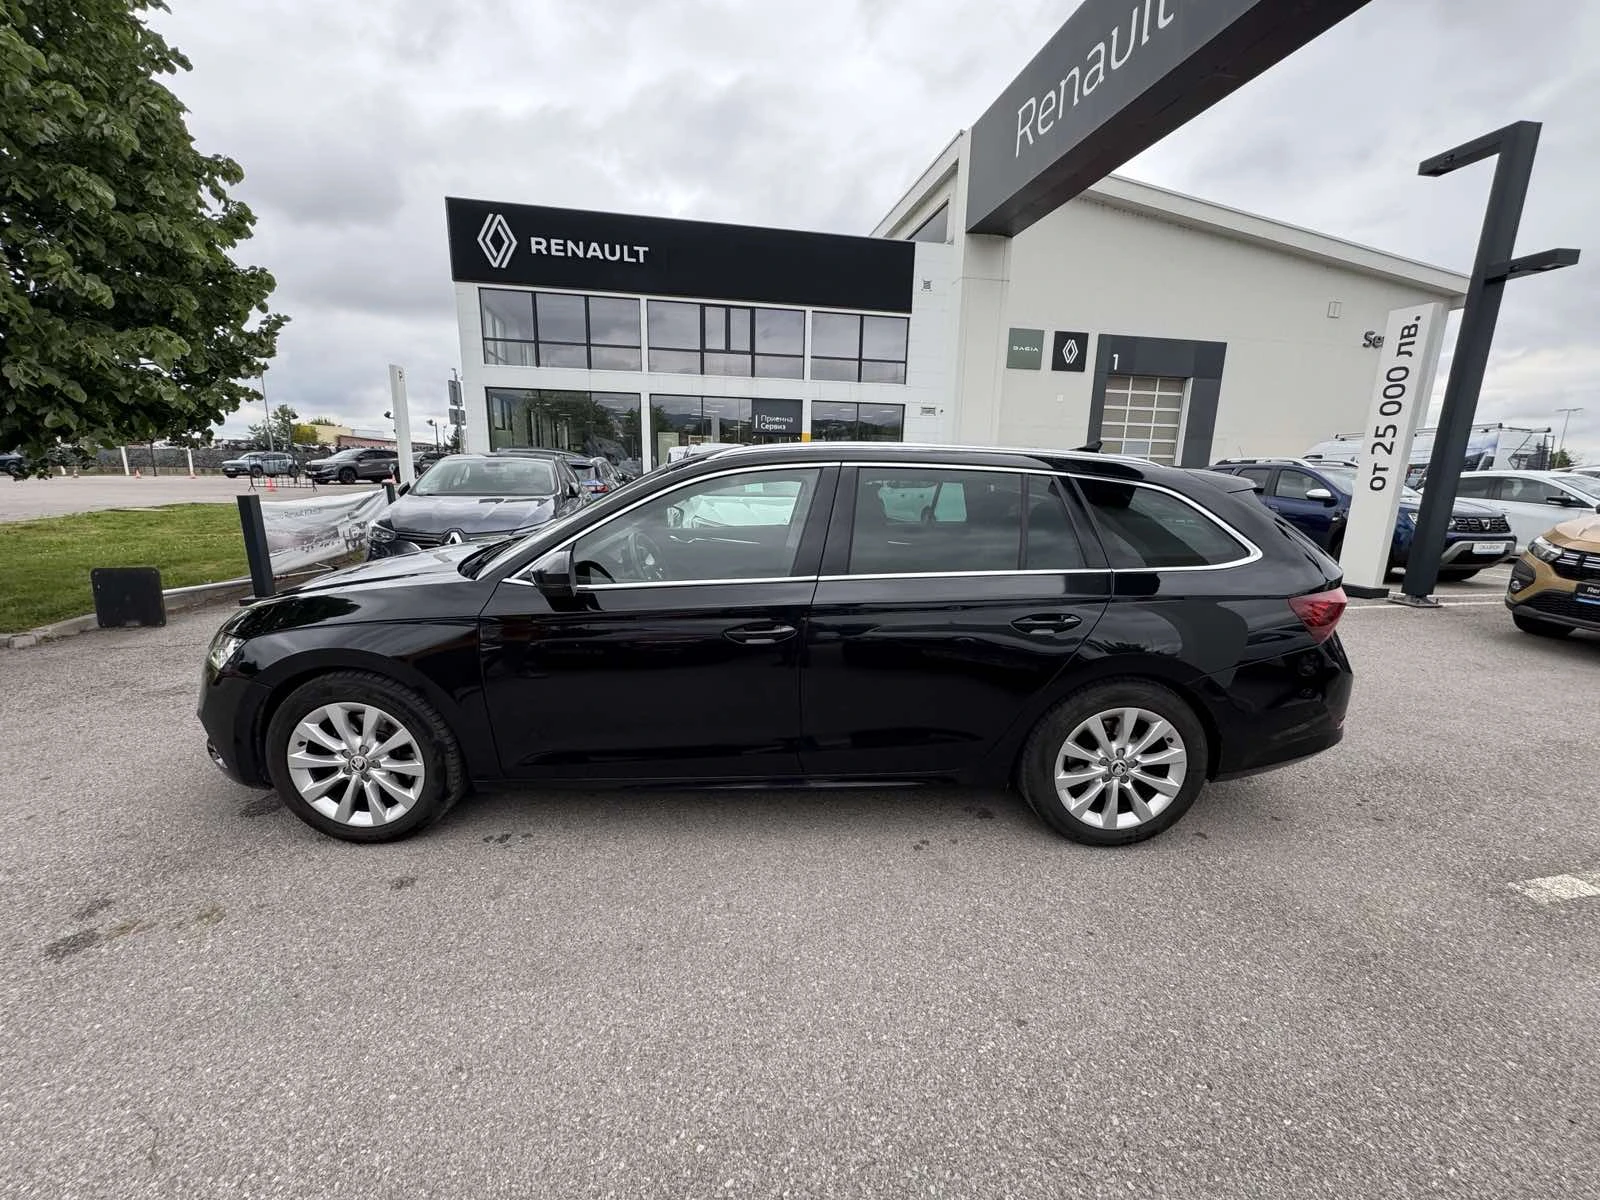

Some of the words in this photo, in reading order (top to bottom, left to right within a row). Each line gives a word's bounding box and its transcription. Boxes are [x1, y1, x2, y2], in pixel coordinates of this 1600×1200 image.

[530, 236, 649, 263] RENAULT
[1396, 315, 1421, 357] лв.
[1113, 353, 1119, 371] 1
[1379, 366, 1409, 416] 000
[1371, 424, 1397, 455] 25
[1369, 462, 1389, 491] от
